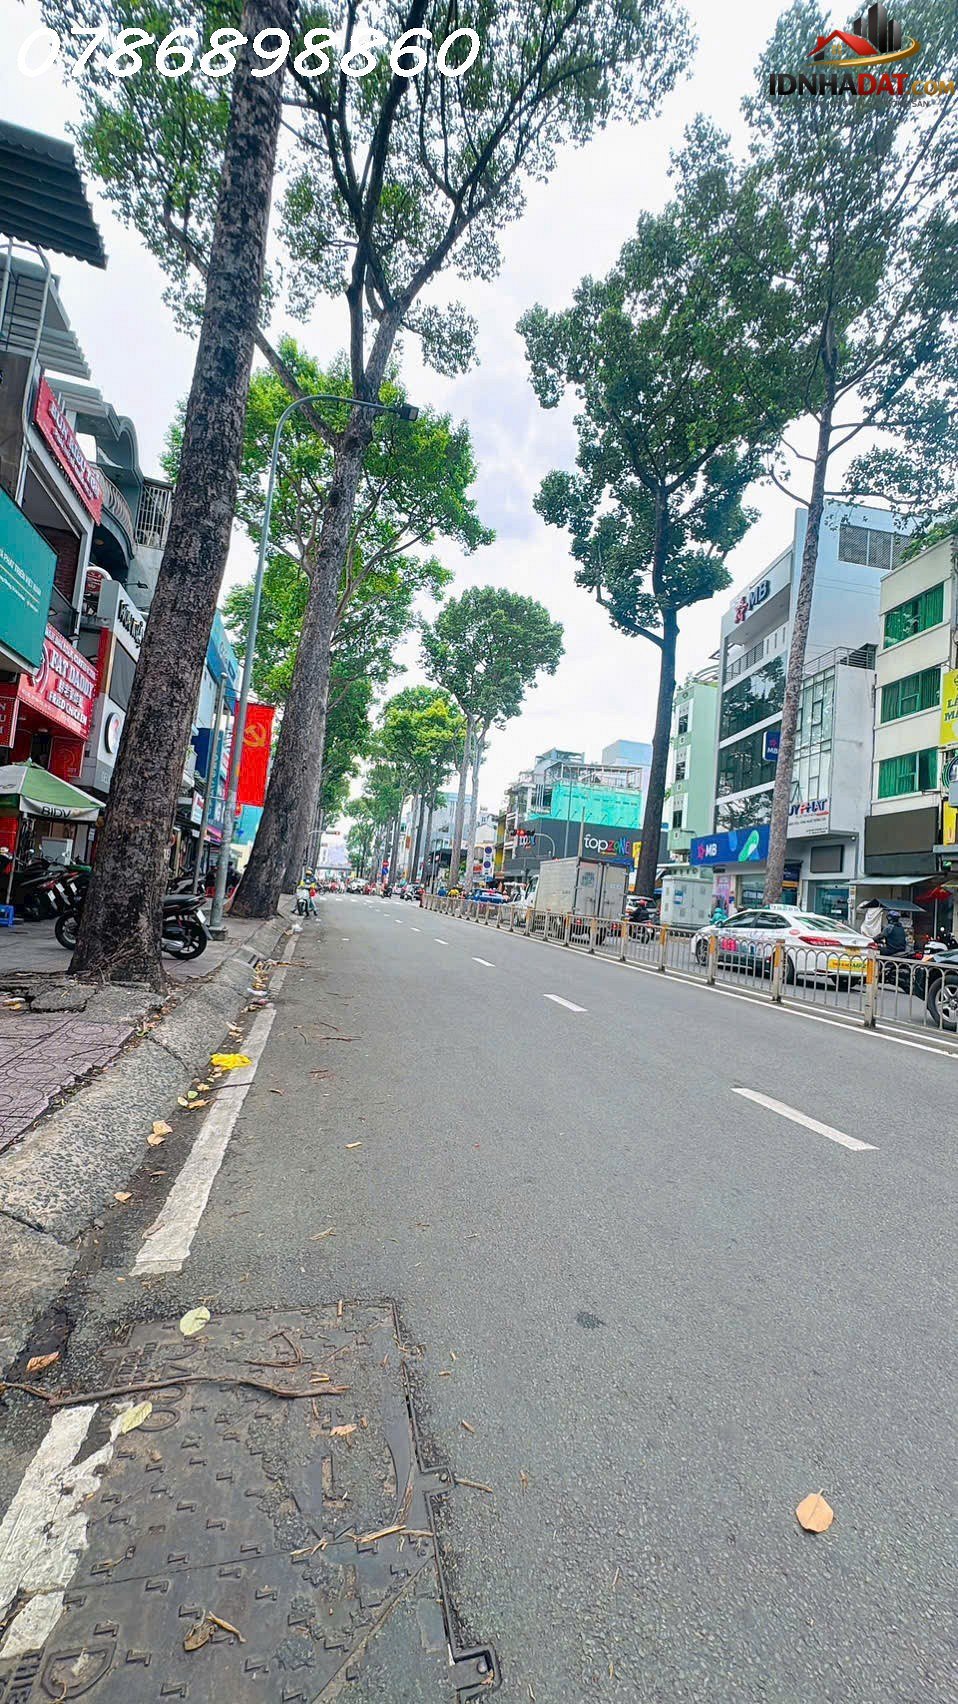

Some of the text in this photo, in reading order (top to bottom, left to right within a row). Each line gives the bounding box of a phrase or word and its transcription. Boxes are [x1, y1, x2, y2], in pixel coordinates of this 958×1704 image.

[749, 580, 770, 611] MB
[50, 649, 69, 679] FAT
[68, 664, 94, 700] DADDY
[49, 691, 66, 710] FRIED
[65, 703, 88, 726] CHICKEN
[41, 806, 71, 818] BIDV
[705, 843, 717, 857] MB
